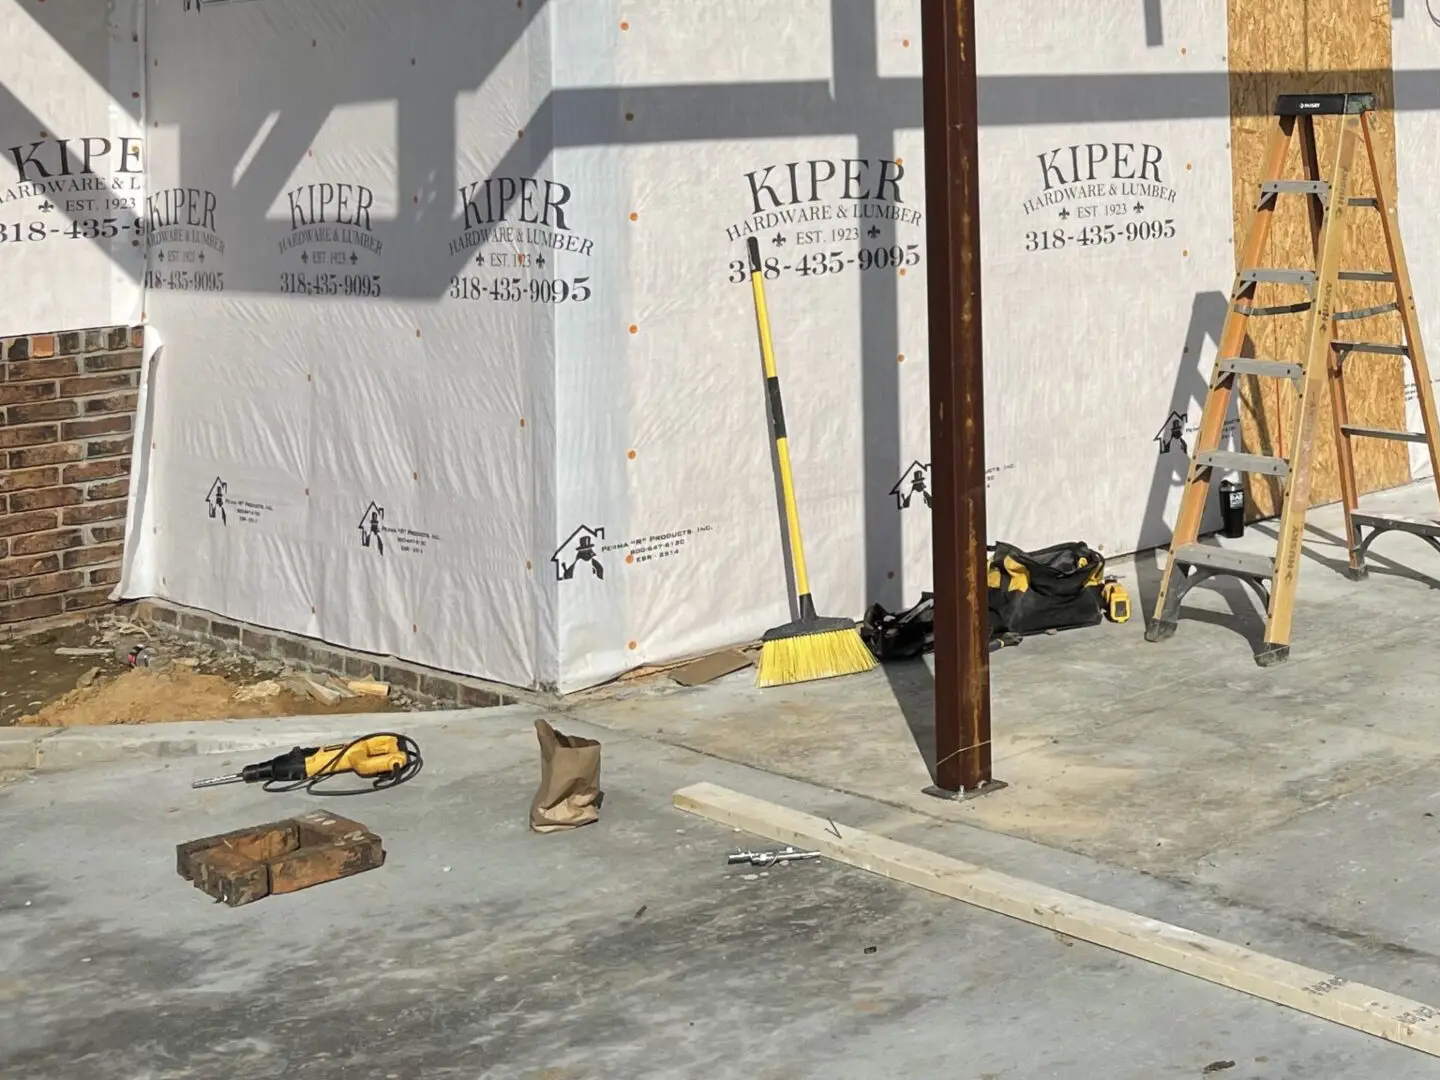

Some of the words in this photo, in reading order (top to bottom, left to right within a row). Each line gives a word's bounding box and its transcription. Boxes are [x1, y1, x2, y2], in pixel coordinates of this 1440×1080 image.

[8, 136, 143, 184] KIPE
[1036, 143, 1162, 191] KIPER
[0, 177, 107, 205] ARDWARE
[111, 177, 124, 190] &
[744, 158, 904, 215] KIPER
[1023, 183, 1106, 215] HARDWARE
[1108, 183, 1117, 196] &
[1122, 182, 1177, 203] LUMBER
[65, 199, 99, 212] EST.
[105, 197, 136, 210] 1923
[146, 188, 216, 233] KIPER
[288, 183, 373, 231] KIPER
[459, 177, 571, 231] KIPER
[1105, 203, 1127, 216] 1923
[725, 204, 832, 242] HARDWARE
[837, 205, 848, 219] &
[853, 203, 922, 226] LUMBER
[796, 231, 827, 245] EST.
[832, 228, 859, 243] 1923
[1026, 219, 1176, 252] 318-435-9095
[147, 229, 183, 248] ARDWARE
[279, 227, 331, 255] HARDWARE
[342, 228, 383, 257] LUMBER
[449, 227, 513, 256] HARDWARE
[517, 228, 524, 243] &
[527, 228, 594, 257] LUMBER
[490, 253, 510, 267] EST.
[729, 244, 920, 283] 38-435-9095
[281, 272, 381, 297] 318-435-9095
[450, 275, 591, 303] 318-435-9095
[601, 542, 629, 552] PERMA
[1287, 524, 1298, 569] HUSKY
